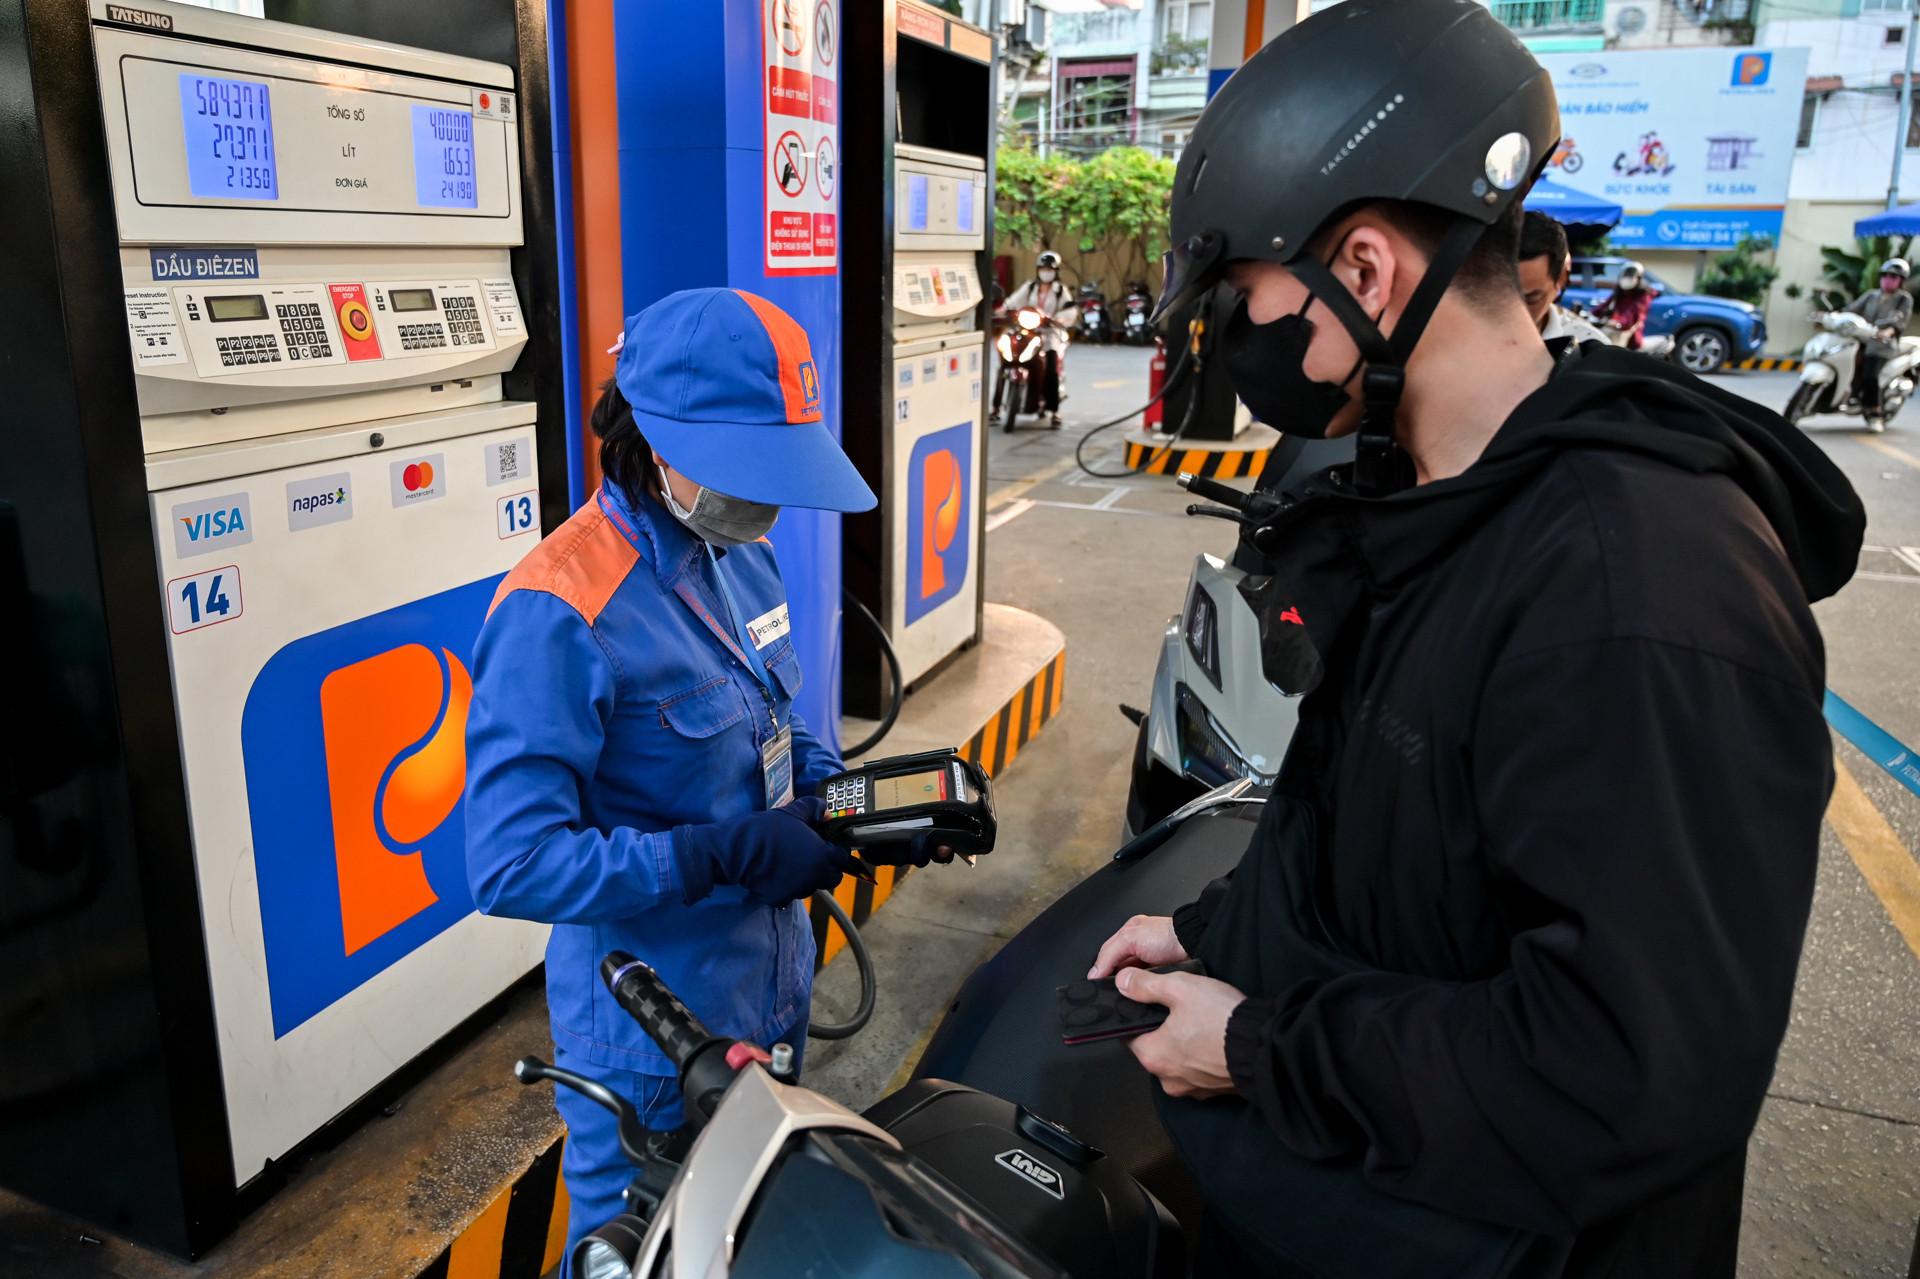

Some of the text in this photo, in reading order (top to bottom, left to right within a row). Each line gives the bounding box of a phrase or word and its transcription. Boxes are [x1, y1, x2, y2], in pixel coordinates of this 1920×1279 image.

[110, 7, 170, 29] TATSUNO
[196, 80, 264, 120] 584371
[327, 105, 365, 121] TỔNG SỐ
[429, 112, 468, 142] 40000
[342, 143, 356, 158] LÍT
[227, 166, 270, 189] 21350
[336, 178, 368, 189] ĐƠN GIÁ
[442, 180, 472, 199] 24190
[156, 252, 255, 277] DẦU ĐIÊZEN
[898, 400, 908, 419] 12
[293, 492, 334, 513] napas
[405, 488, 434, 500] mastercard
[180, 507, 245, 542] VISA
[505, 496, 532, 532] 13
[182, 574, 230, 624] 14
[1010, 1154, 1056, 1183] GIVI
